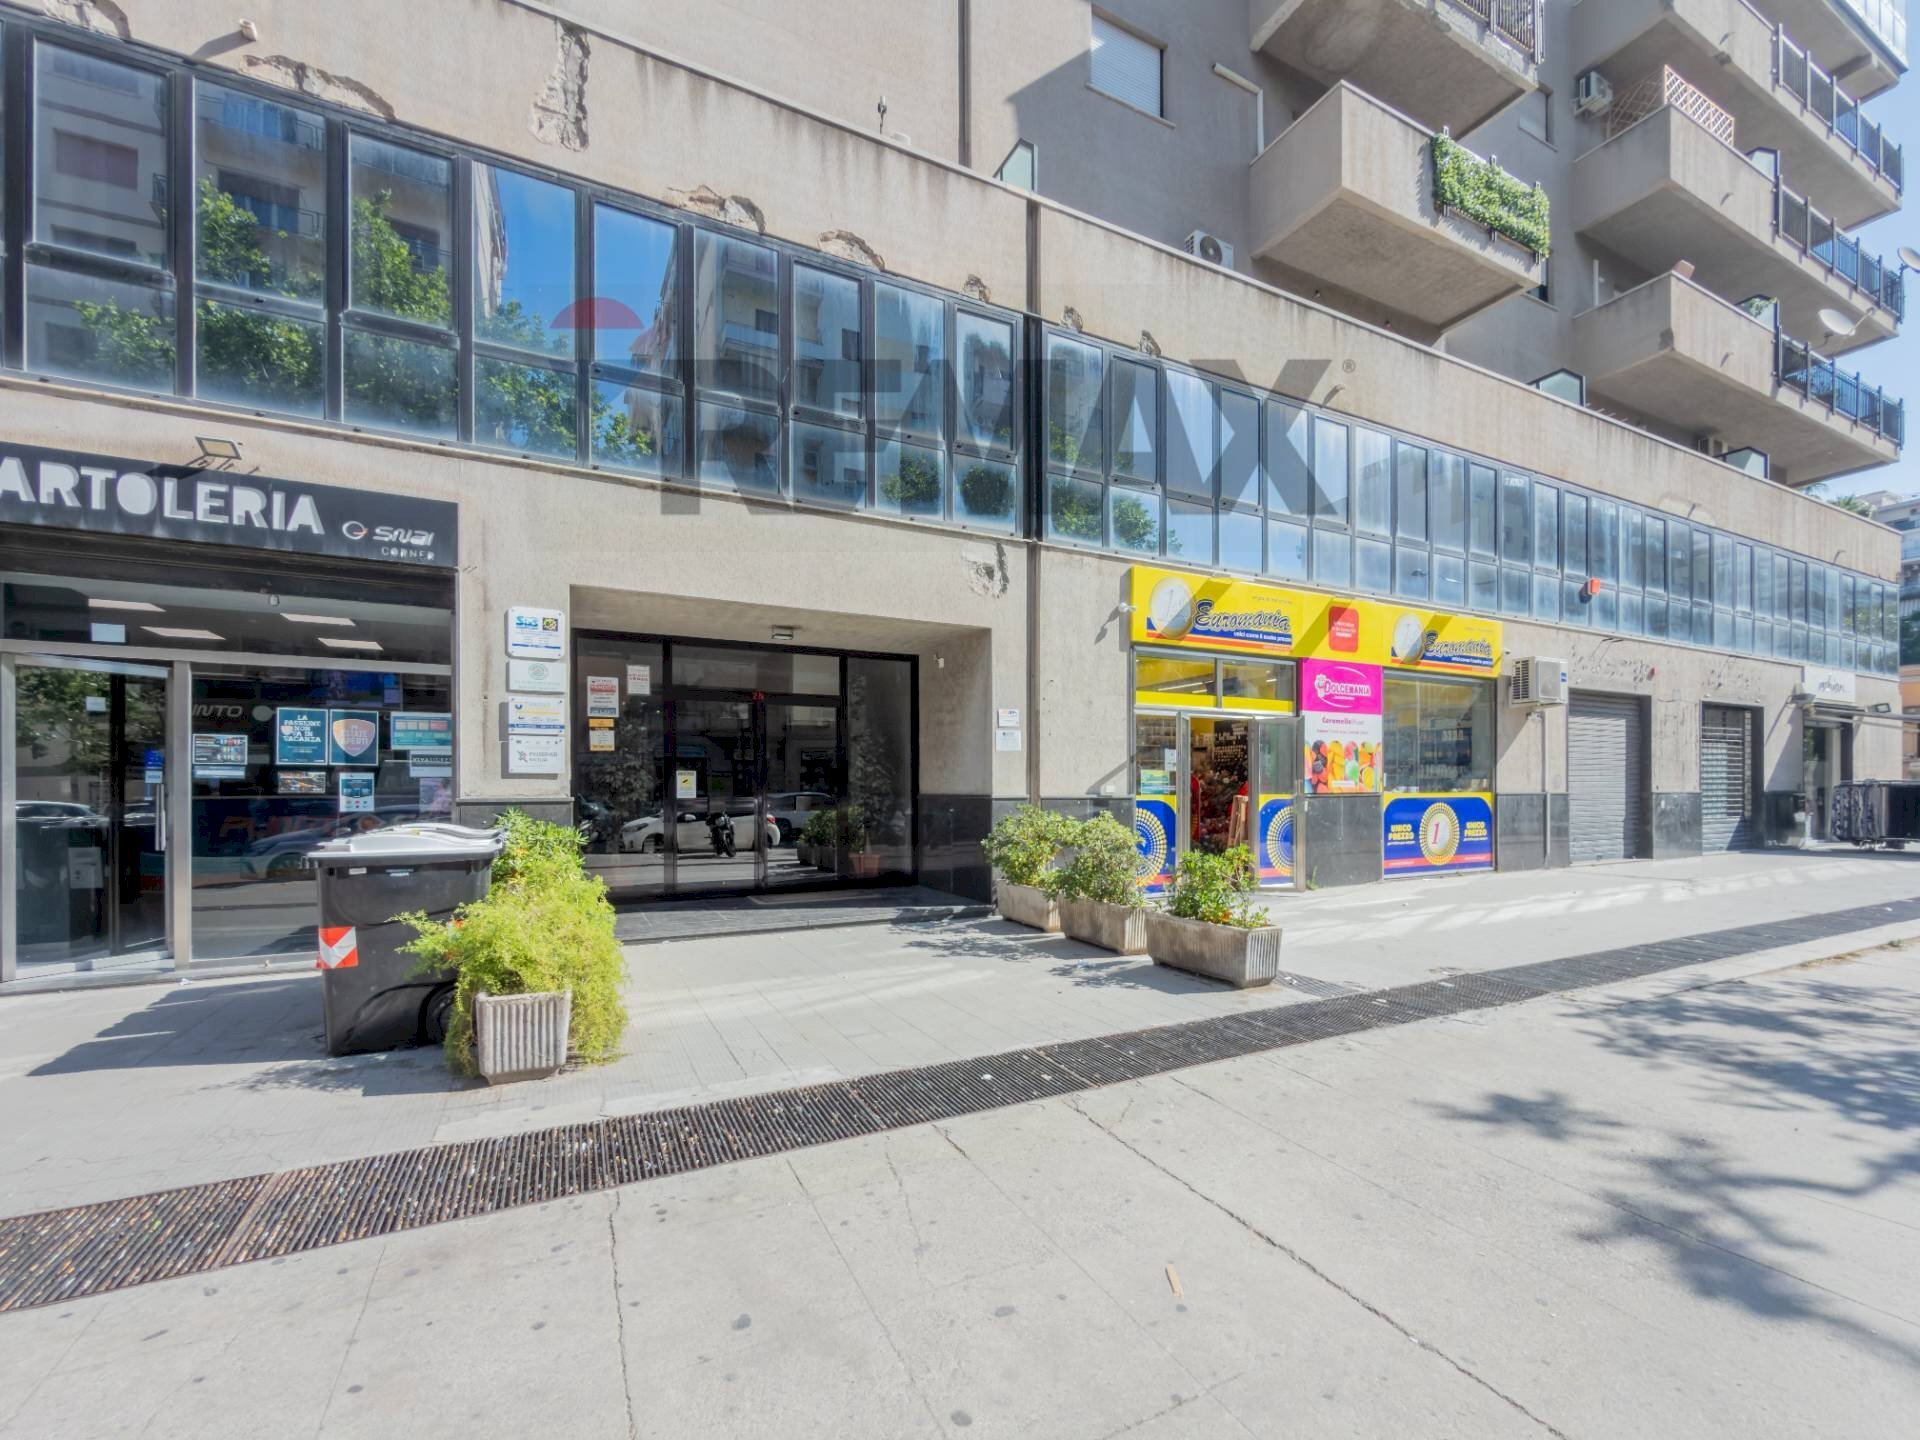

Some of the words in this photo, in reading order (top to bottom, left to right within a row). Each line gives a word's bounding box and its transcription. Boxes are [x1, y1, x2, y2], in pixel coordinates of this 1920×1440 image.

[0, 456, 325, 535] ARTOLERIA
[381, 546, 435, 561] CORNER
[1194, 599, 1291, 632] Euromania
[1388, 832, 1414, 841] PREZZO
[1390, 824, 1412, 832] UNICO
[1431, 820, 1441, 845] 1
